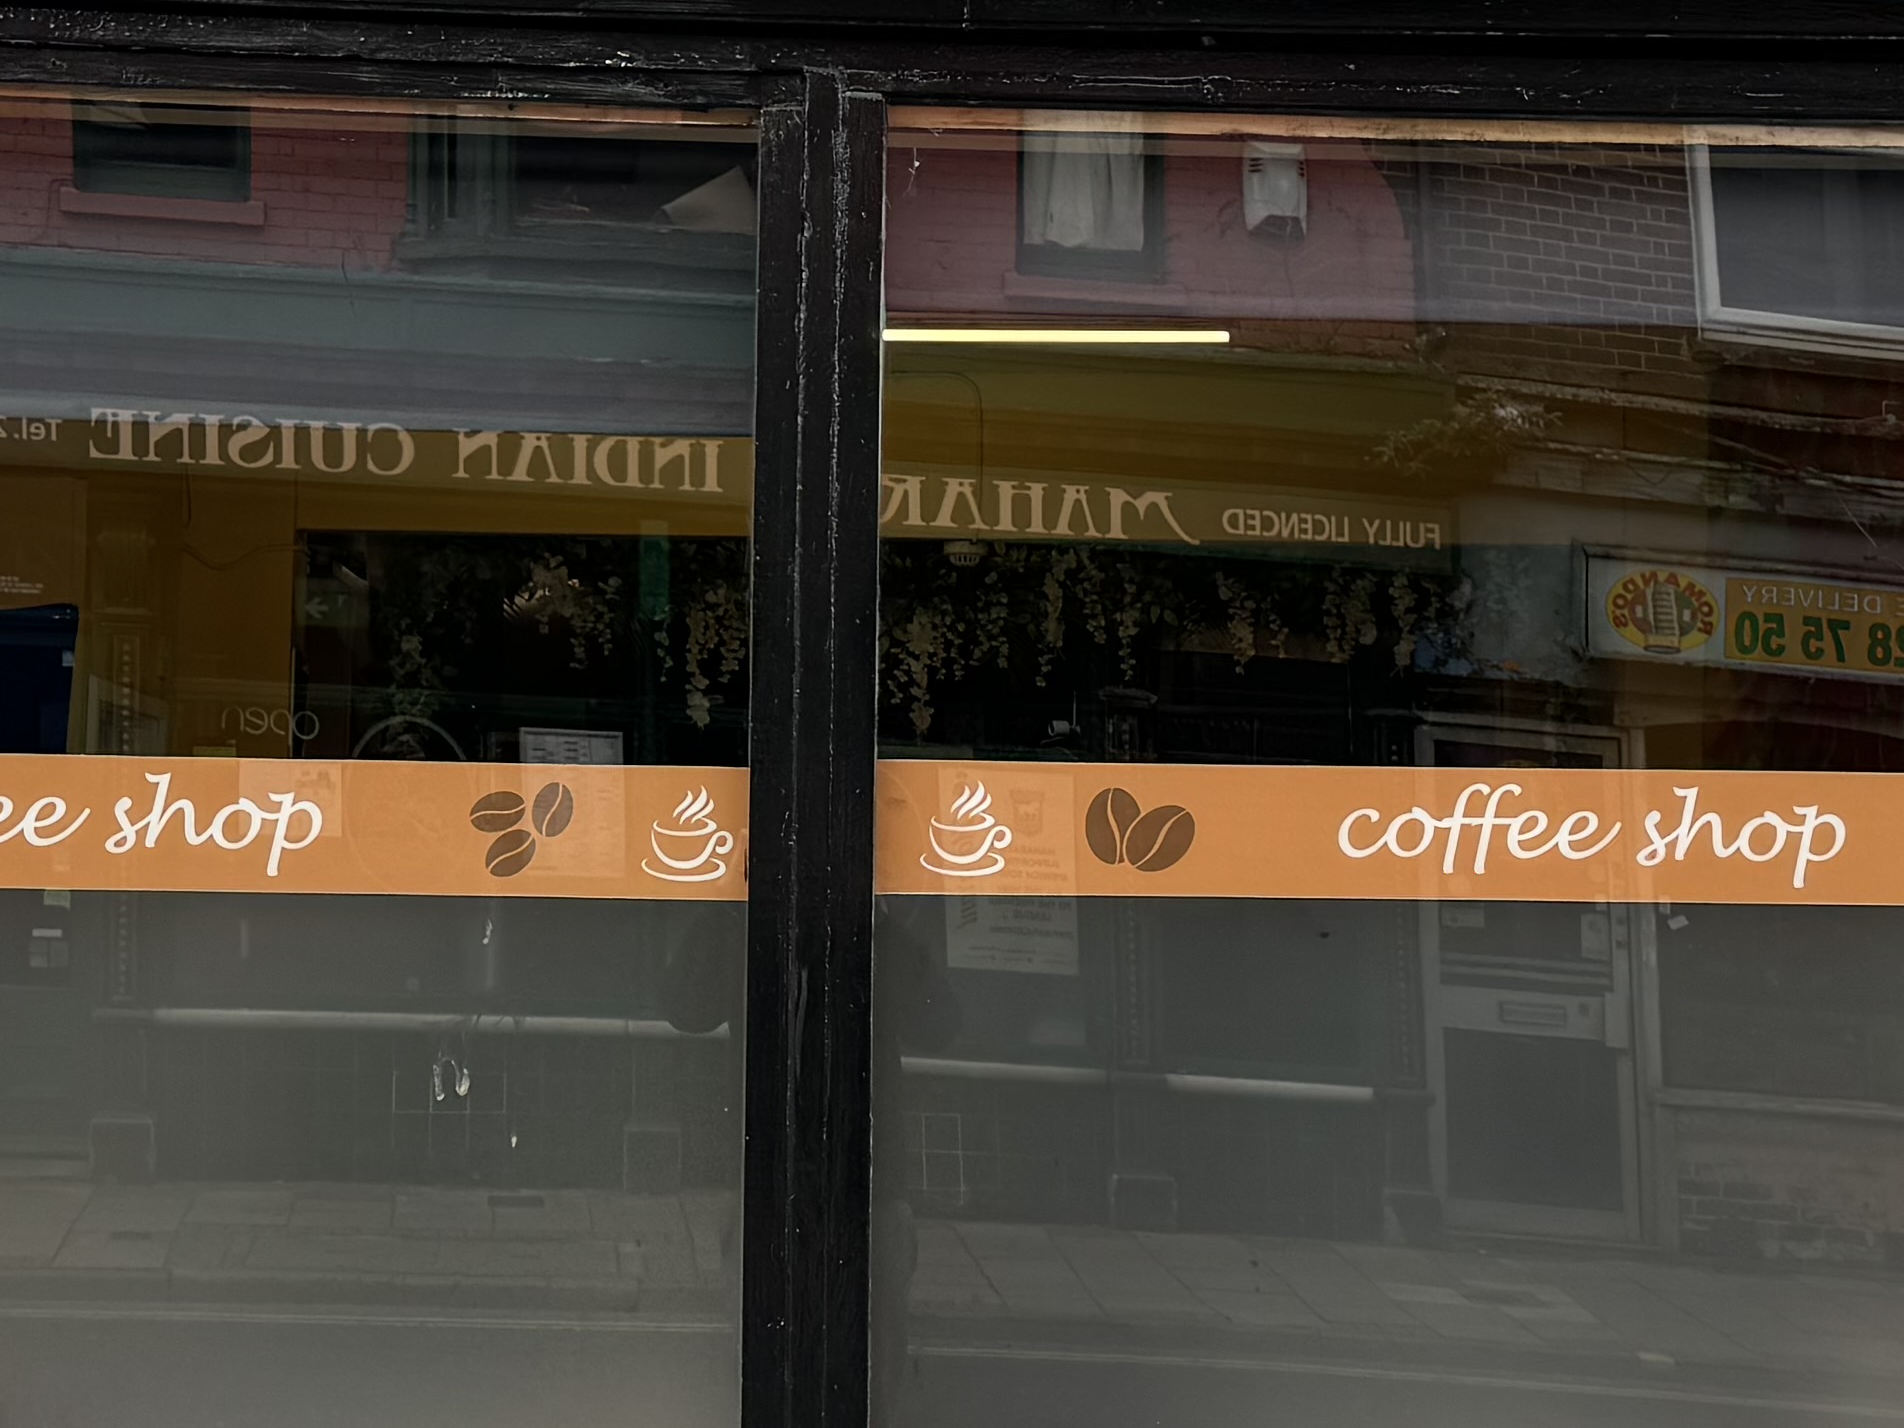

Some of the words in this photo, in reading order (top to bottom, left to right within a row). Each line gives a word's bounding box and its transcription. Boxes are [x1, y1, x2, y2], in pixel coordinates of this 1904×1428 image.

[105, 772, 323, 876] shop
[1337, 782, 1622, 875] coffee
[1636, 785, 1847, 889] shop
